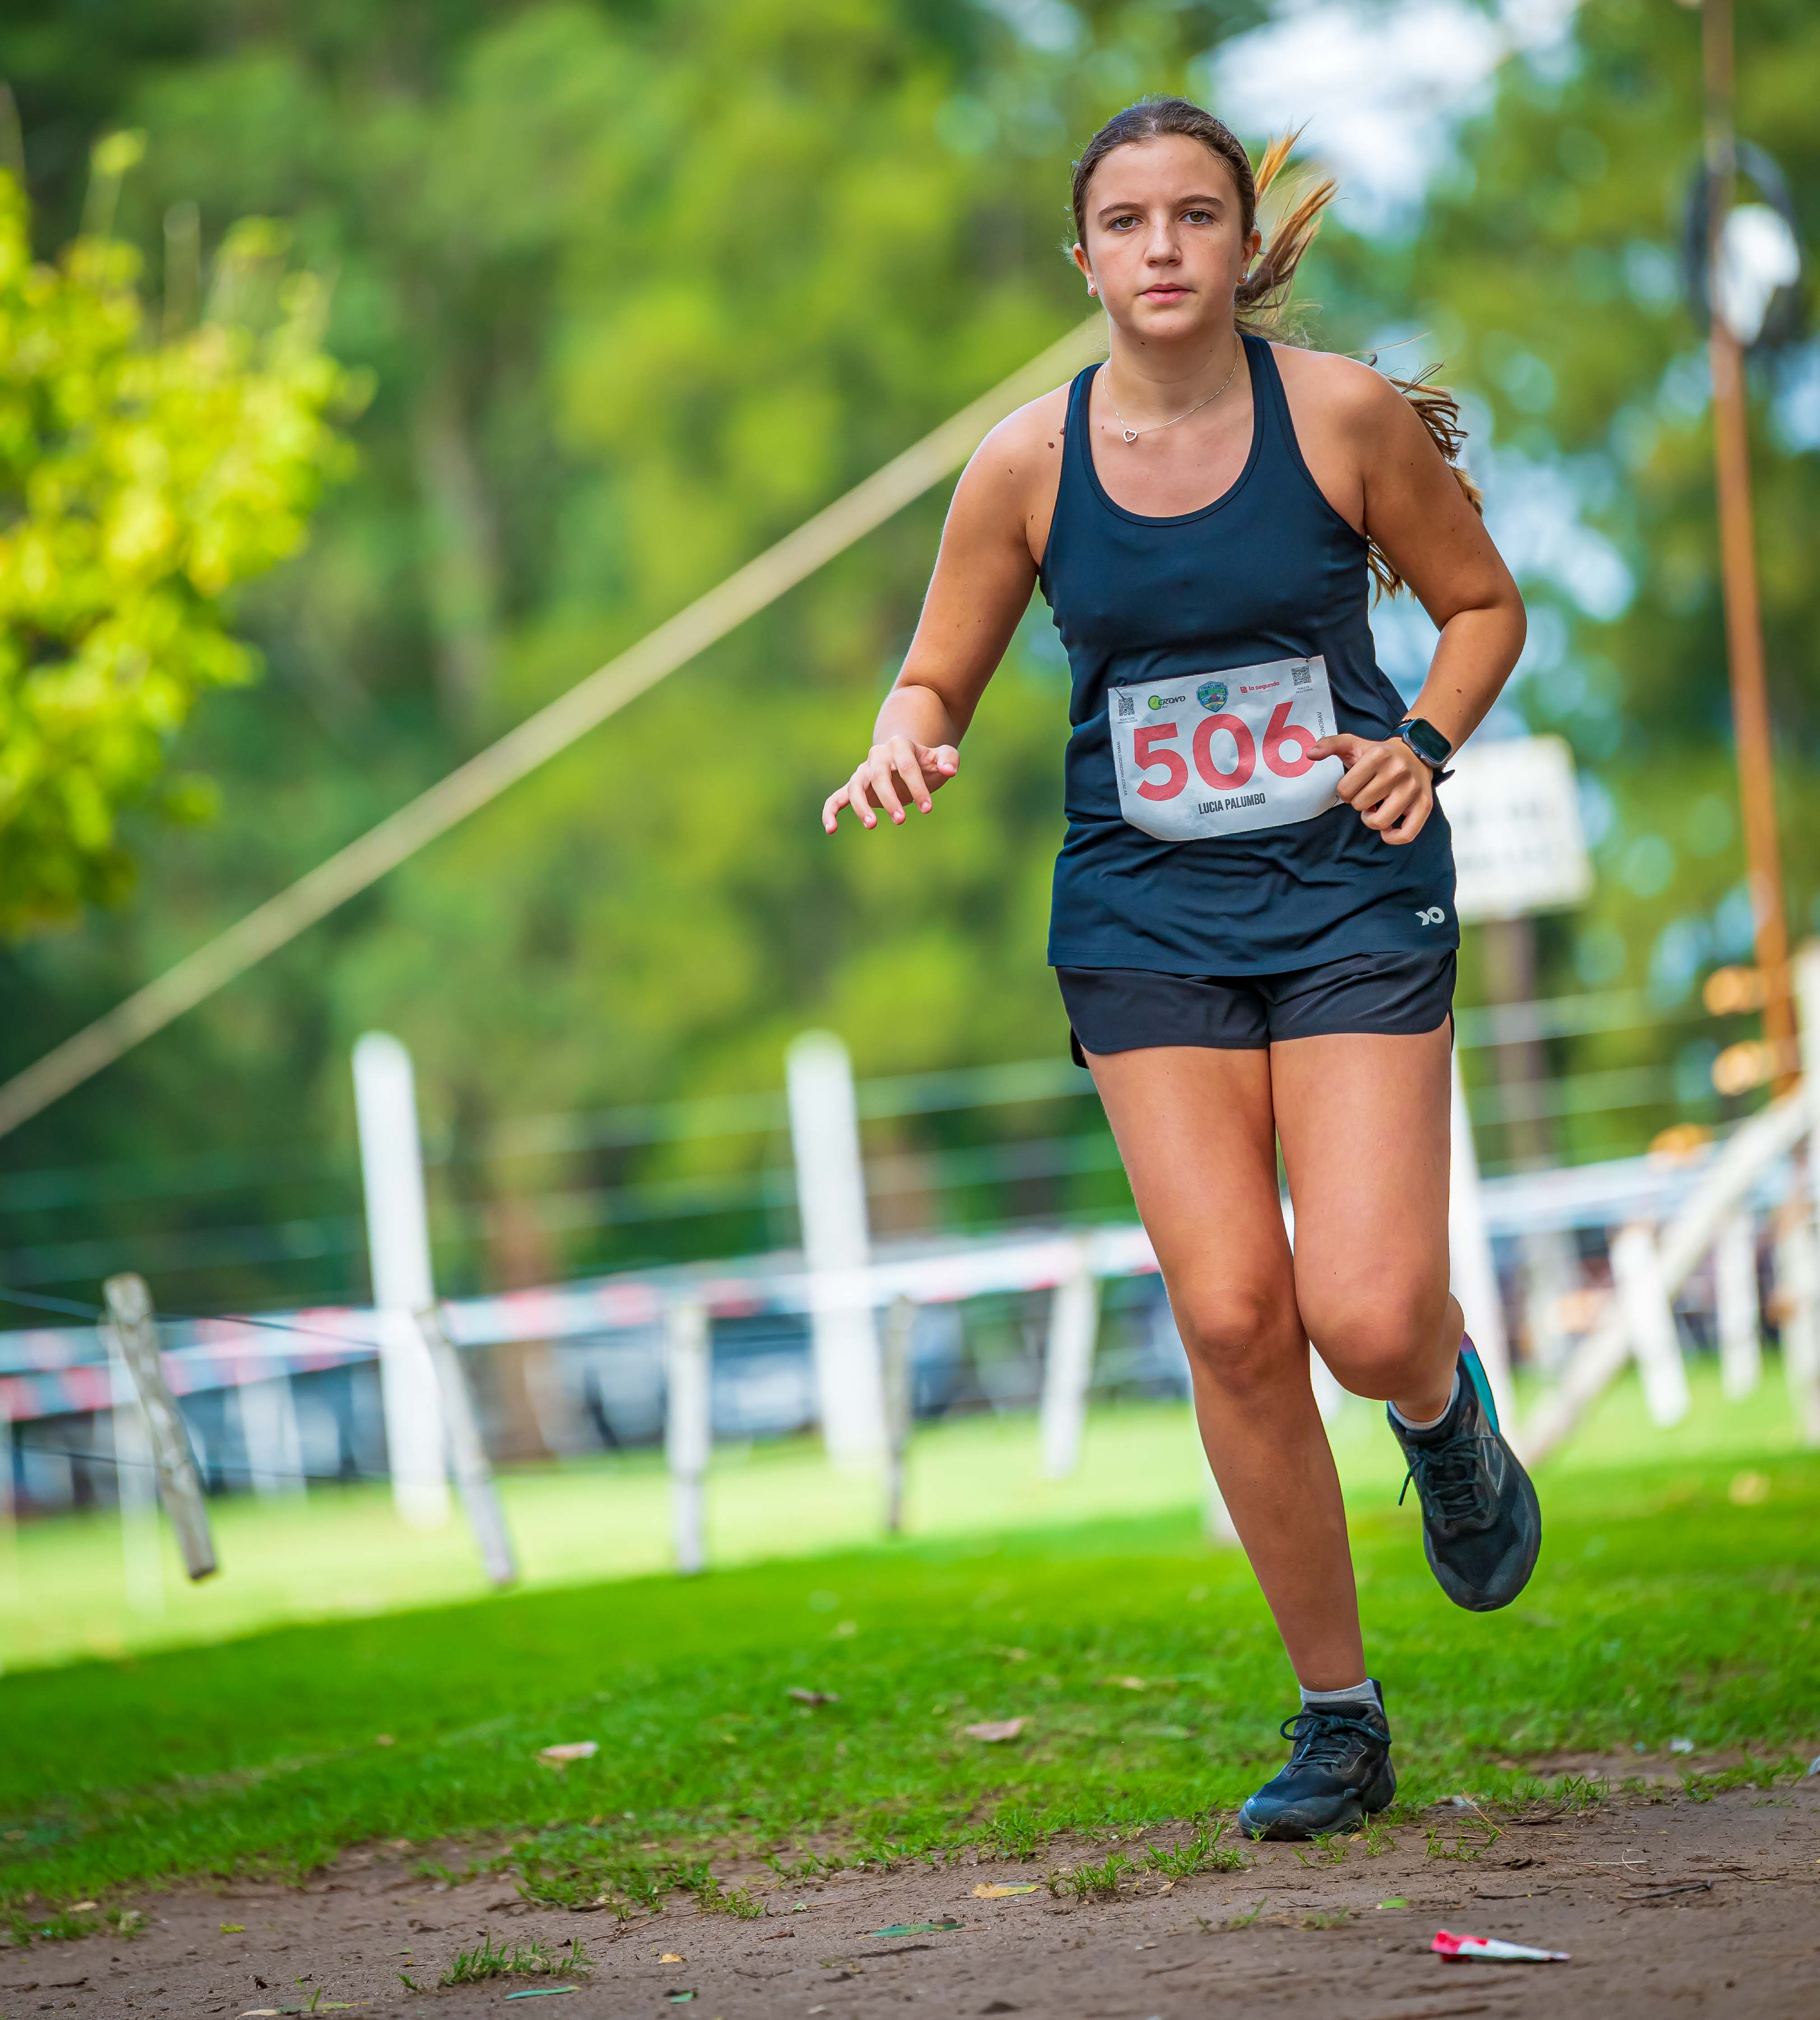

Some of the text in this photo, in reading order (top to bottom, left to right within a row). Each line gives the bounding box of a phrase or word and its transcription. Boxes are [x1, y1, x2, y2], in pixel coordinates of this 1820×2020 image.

[1255, 681, 1280, 690] segunda
[1117, 741, 1128, 796] WWW.CRONORAV.COM.AR
[1133, 701, 1317, 802] 506
[1198, 792, 1266, 815] LUCIA PALUMBO
